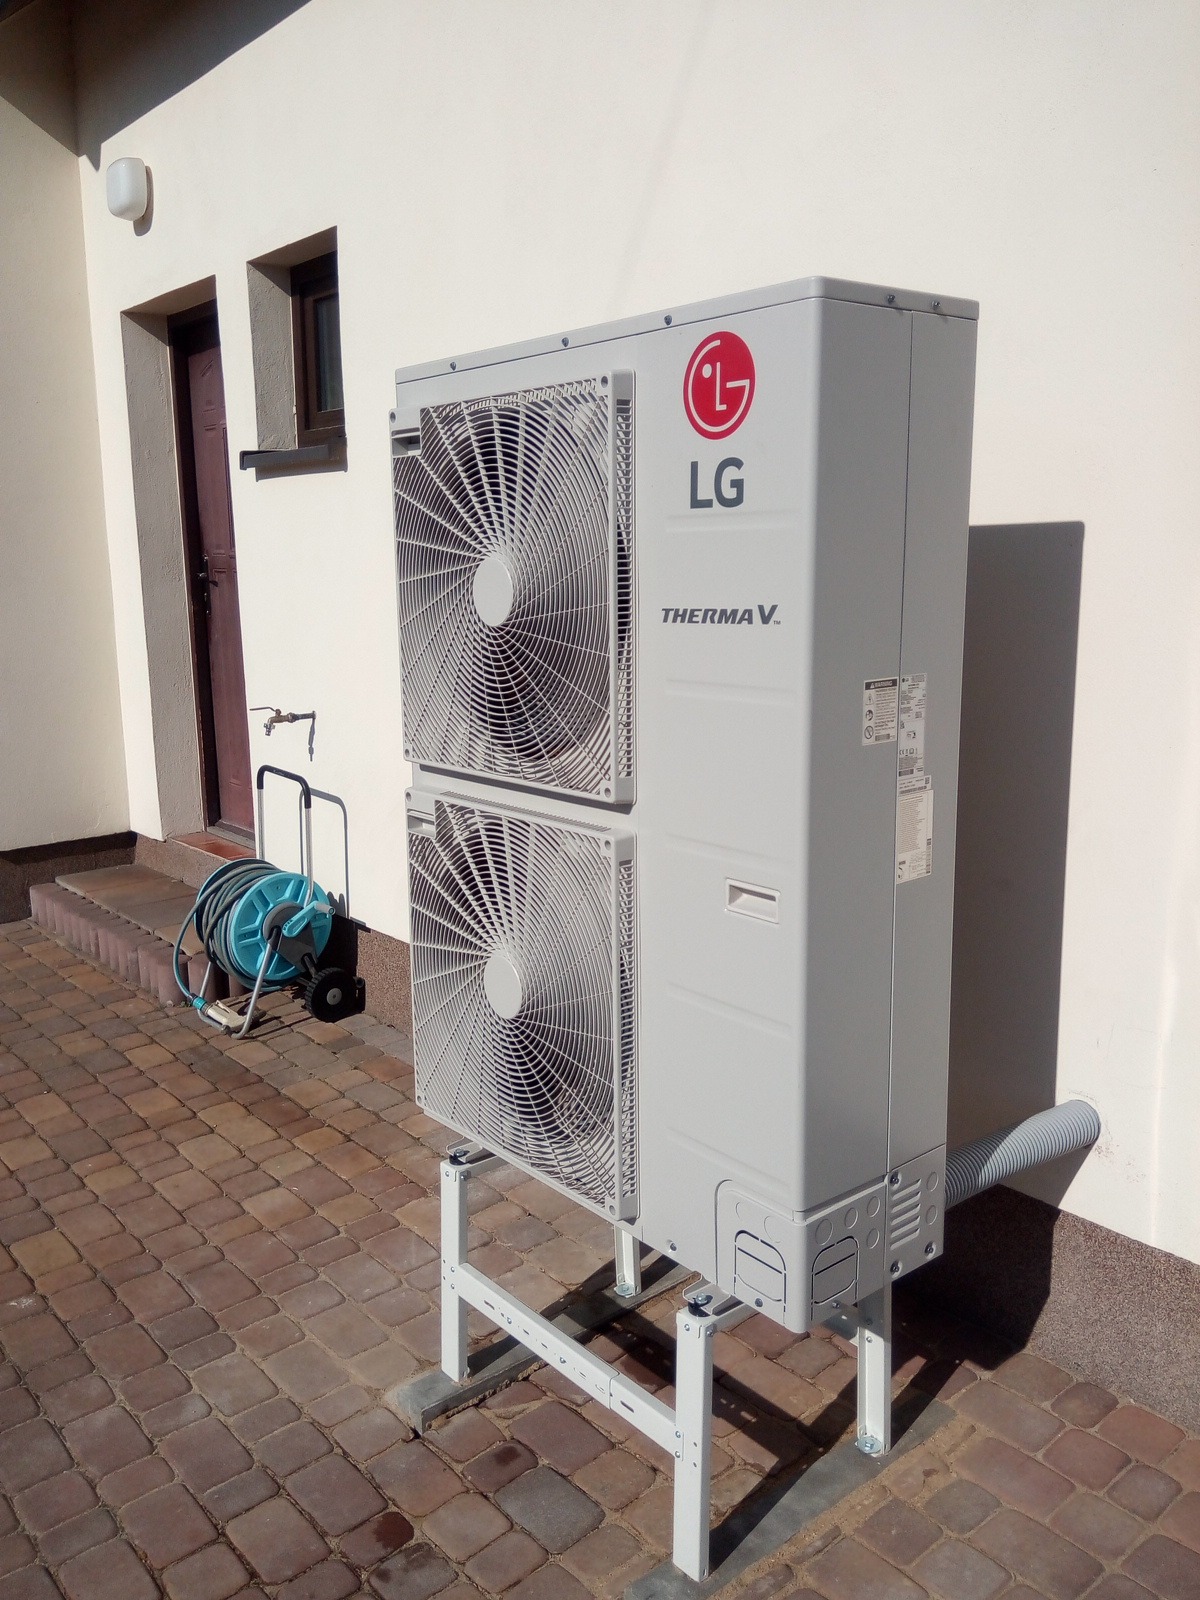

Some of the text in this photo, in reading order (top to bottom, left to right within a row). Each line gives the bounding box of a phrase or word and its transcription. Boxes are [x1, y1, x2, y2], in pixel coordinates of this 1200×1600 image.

[687, 339, 751, 433] LG
[689, 457, 745, 509] LG
[661, 608, 754, 625] THERMA
